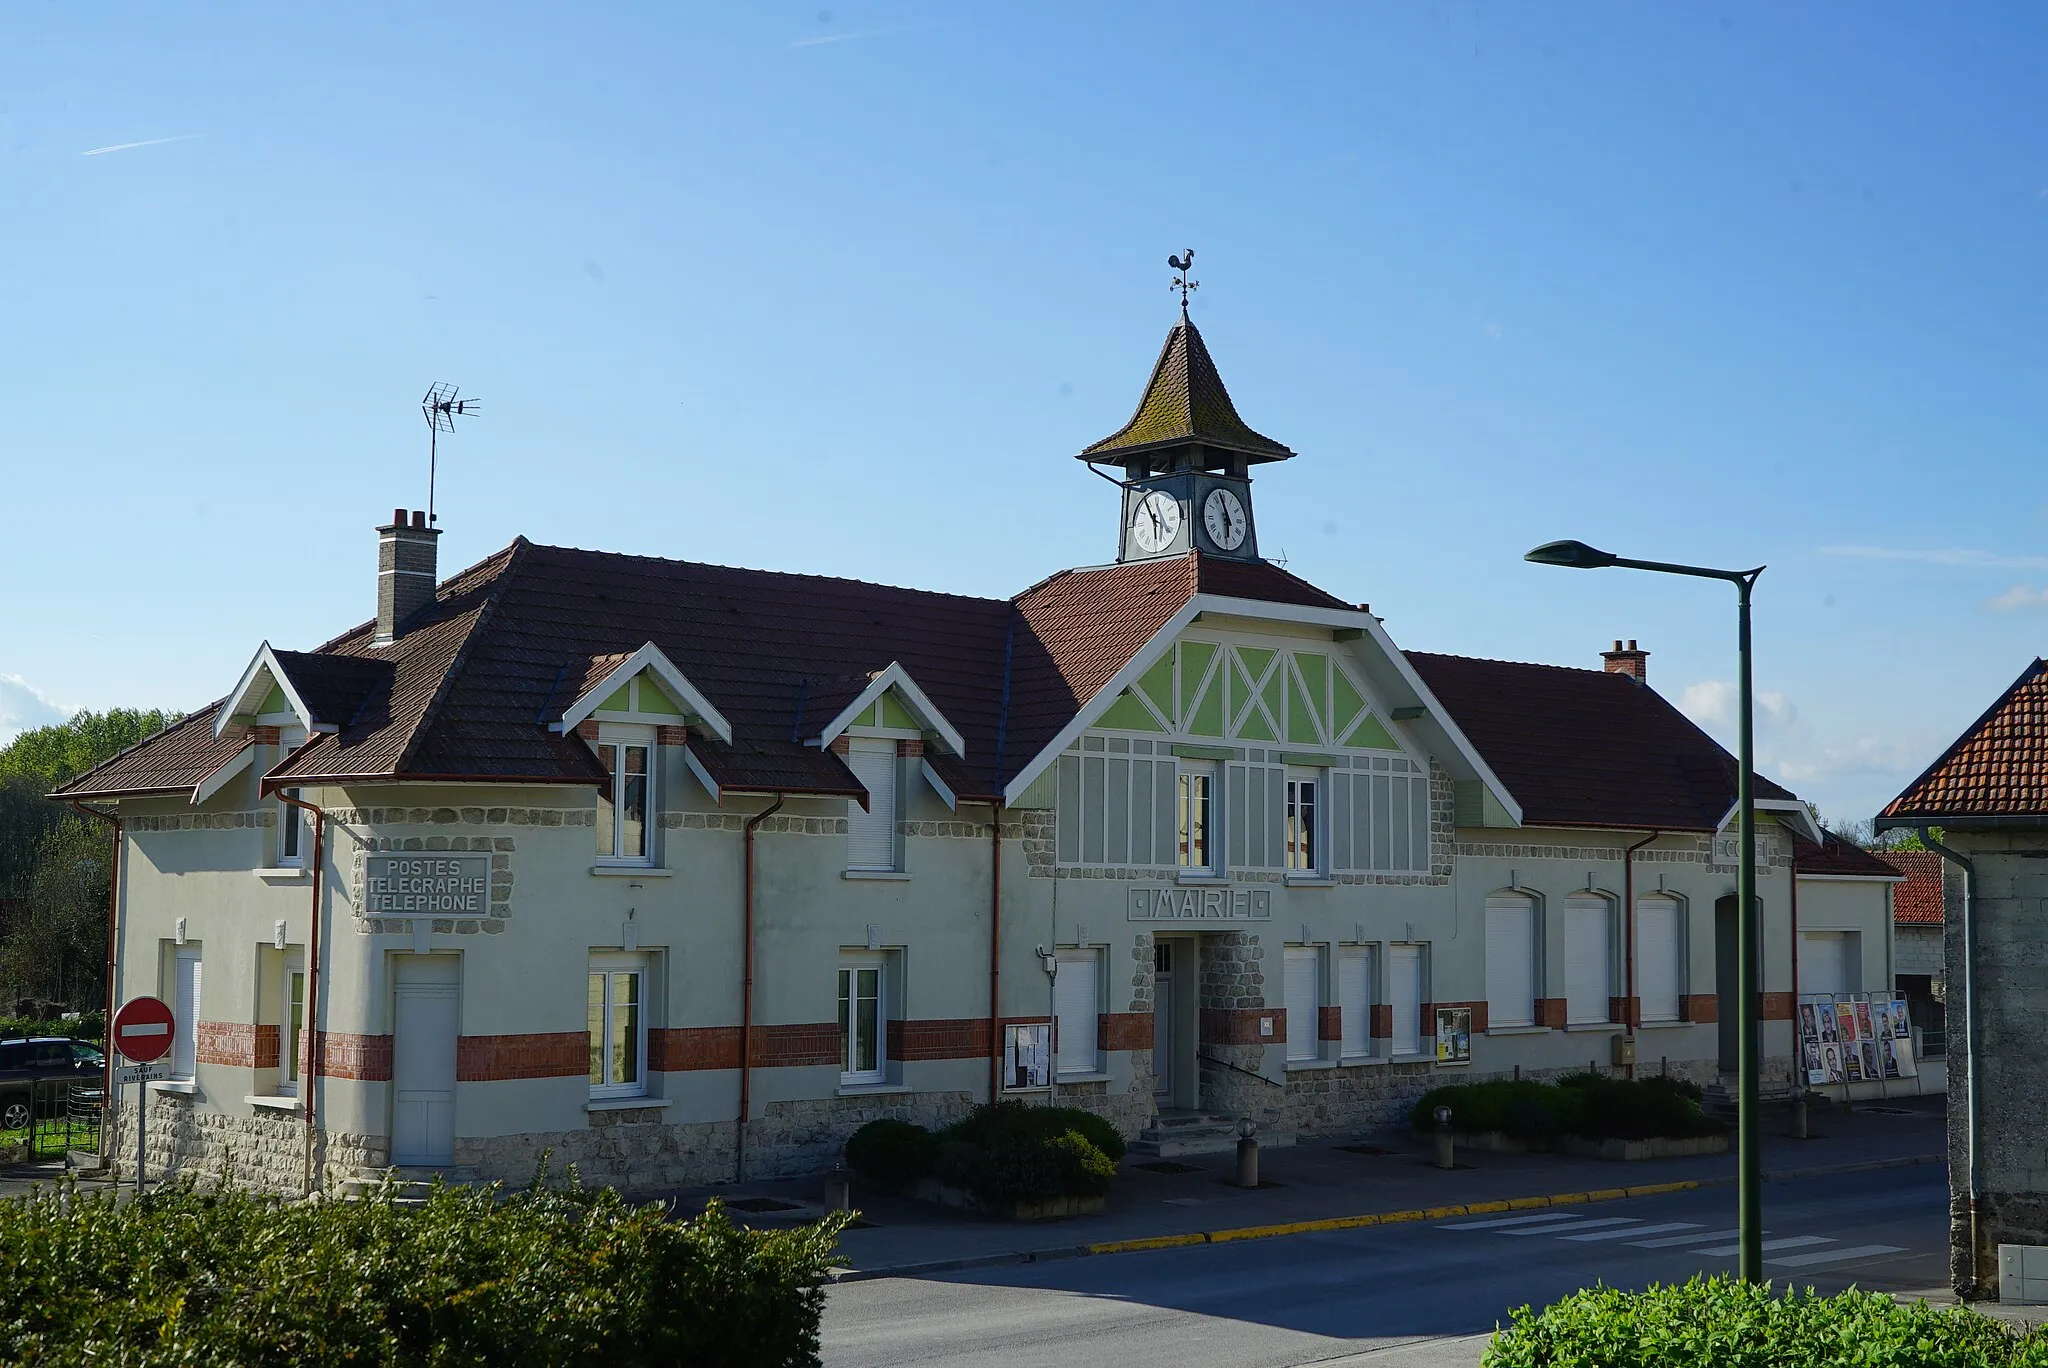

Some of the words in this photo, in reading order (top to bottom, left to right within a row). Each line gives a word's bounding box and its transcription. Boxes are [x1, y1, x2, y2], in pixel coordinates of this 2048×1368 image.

[387, 860, 461, 876] POSTES
[368, 877, 485, 894] TELEGRAPHE
[371, 894, 478, 911] TELEPHONE
[1154, 889, 1249, 918] MAIRIE
[123, 1072, 163, 1082] RIVERAINS
[134, 1066, 153, 1074] SAUF
